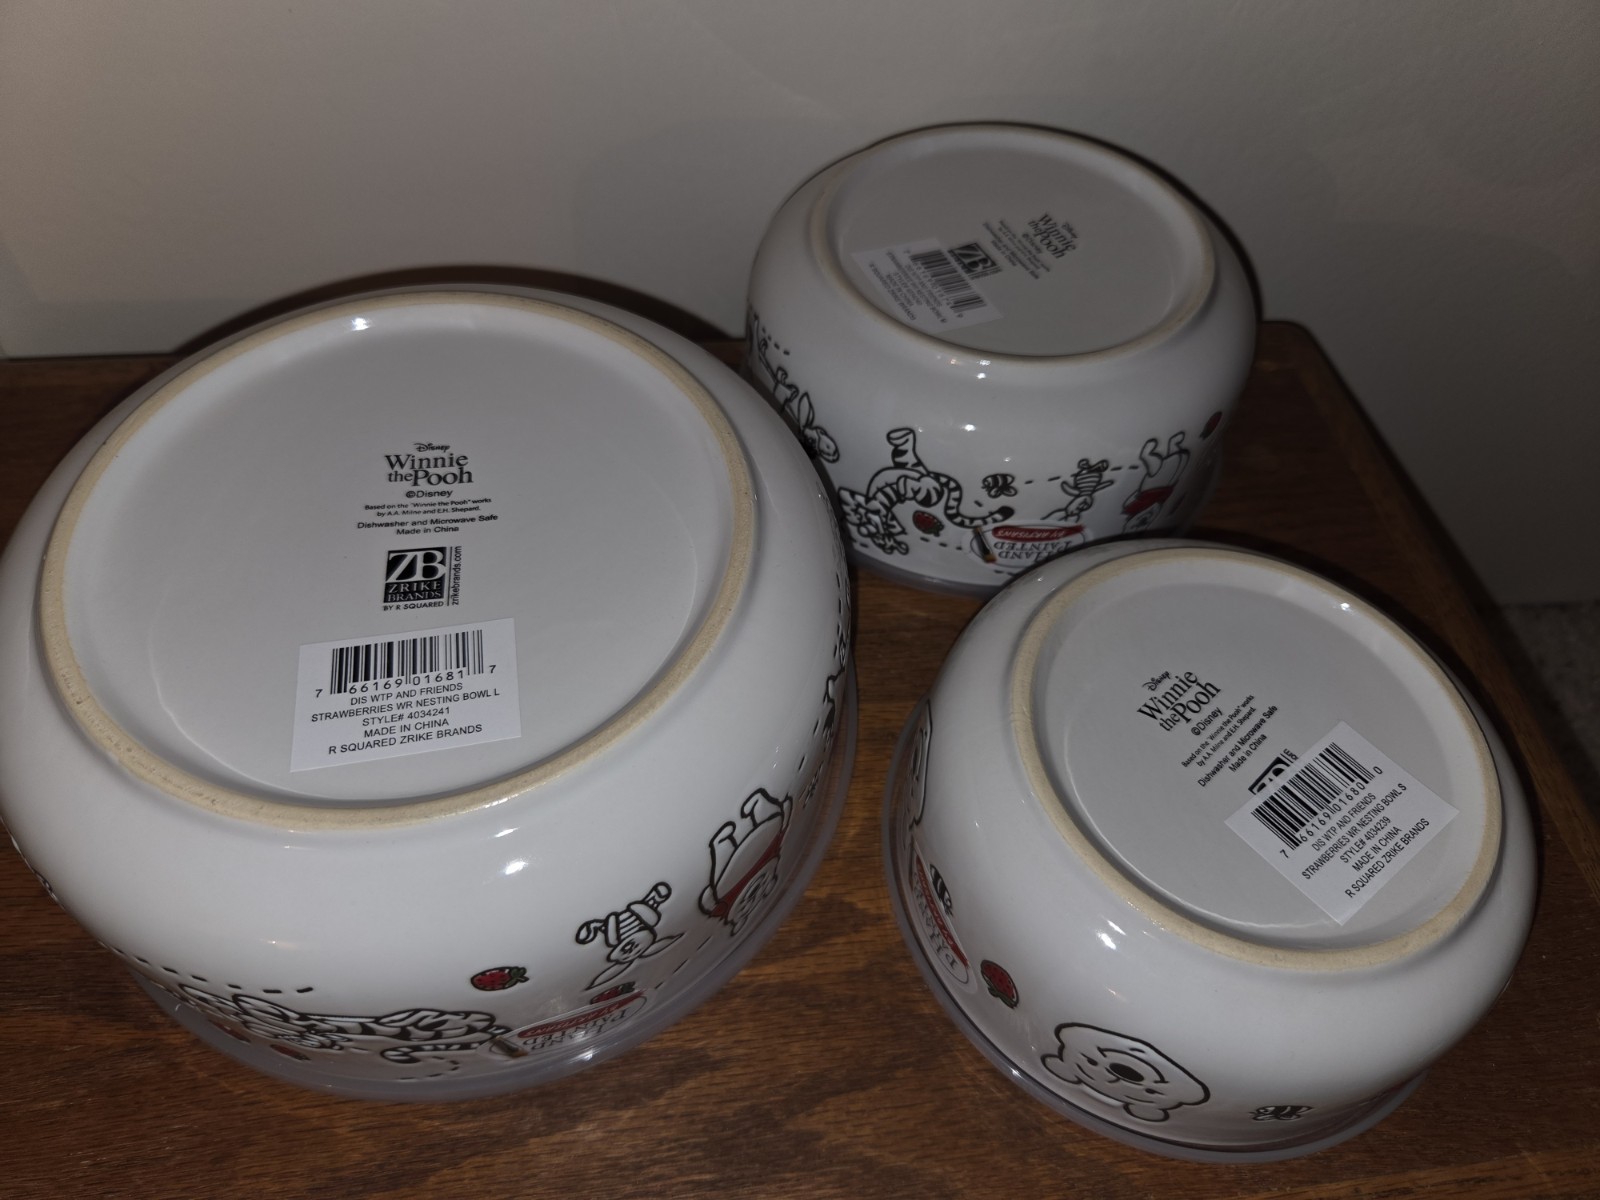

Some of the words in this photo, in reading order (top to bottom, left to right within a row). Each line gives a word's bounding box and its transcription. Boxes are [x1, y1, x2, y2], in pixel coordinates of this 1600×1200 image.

[1034, 229, 1067, 260] Pooh
[1038, 212, 1077, 252] Winnie
[385, 453, 468, 470] Winnie
[414, 443, 450, 452] Disney
[388, 471, 413, 482] the
[412, 467, 473, 486] Pooh
[406, 490, 453, 498] ©Disney
[358, 520, 409, 529] Dishwasher
[430, 516, 475, 525] Microwave
[479, 514, 498, 522] Safe
[993, 540, 1072, 551] PAINTED
[386, 550, 447, 582] ZB
[452, 546, 462, 605] zrikebrands.com
[388, 591, 441, 602] BRANDS
[389, 581, 441, 593] ZRIKE
[404, 601, 444, 610] SQUARED
[315, 689, 323, 698] 7
[349, 679, 403, 694] 66169
[413, 670, 464, 686] 01681
[489, 665, 497, 674] 7
[350, 696, 367, 705] DIS
[371, 693, 393, 703] WTP
[396, 689, 417, 699] AND
[420, 682, 463, 695] FRIENDS
[1137, 671, 1198, 721] Winnie
[1141, 671, 1171, 691] Disney
[311, 704, 393, 722] STRAWBERRIES
[396, 701, 413, 710] WR
[416, 695, 460, 708] NESTING
[463, 690, 492, 701] BOWL
[494, 688, 500, 696] L
[362, 713, 404, 726] STYLE#
[408, 707, 450, 719] 4034241
[1159, 713, 1180, 732] the
[1170, 680, 1221, 724] Pooh
[364, 726, 396, 738] MADE
[400, 724, 410, 732] IN
[415, 718, 449, 731] CHINA
[1181, 753, 1197, 767] Based
[1195, 747, 1203, 757] on
[1200, 740, 1210, 750] the
[1222, 718, 1232, 729] the
[1241, 695, 1254, 708] works
[1190, 707, 1223, 736] ©Disney
[328, 745, 336, 754] R
[341, 737, 396, 753] SQUARED
[399, 733, 433, 744] ZRIKE
[437, 724, 483, 739] BRANDS
[1196, 757, 1206, 767] by
[1211, 739, 1224, 753] Milne
[1222, 731, 1232, 741] and
[1197, 755, 1230, 787] Dishwasher
[1229, 745, 1241, 757] and
[1237, 718, 1266, 746] Microwave
[1262, 705, 1278, 719] Safe
[1228, 754, 1247, 772] Made
[1244, 747, 1252, 757] in
[1249, 733, 1267, 751] China
[1280, 849, 1289, 859] 7
[1299, 812, 1332, 843] 66169
[1332, 782, 1366, 812] 01680
[1373, 765, 1383, 775] 0
[1311, 835, 1325, 851] DIS
[1321, 822, 1338, 841] WTP
[1338, 814, 1353, 830] AND
[1350, 792, 1376, 819] FRIENDS
[1301, 835, 1350, 880] STRAWBERRIES
[1347, 823, 1359, 840] WR
[1358, 804, 1385, 831] NESTING
[1383, 787, 1402, 811] BOWL
[1398, 783, 1407, 791] S
[1340, 840, 1367, 864] STYLE#
[1365, 815, 1391, 842] 4034239
[1345, 889, 1356, 898] R
[1351, 860, 1385, 892] SQUARED
[1383, 840, 1404, 865] ZRIKE
[1401, 818, 1430, 845] BRANDS
[1352, 853, 1373, 872] MADE
[1370, 843, 1382, 856] IN
[1378, 826, 1402, 849] CHINA
